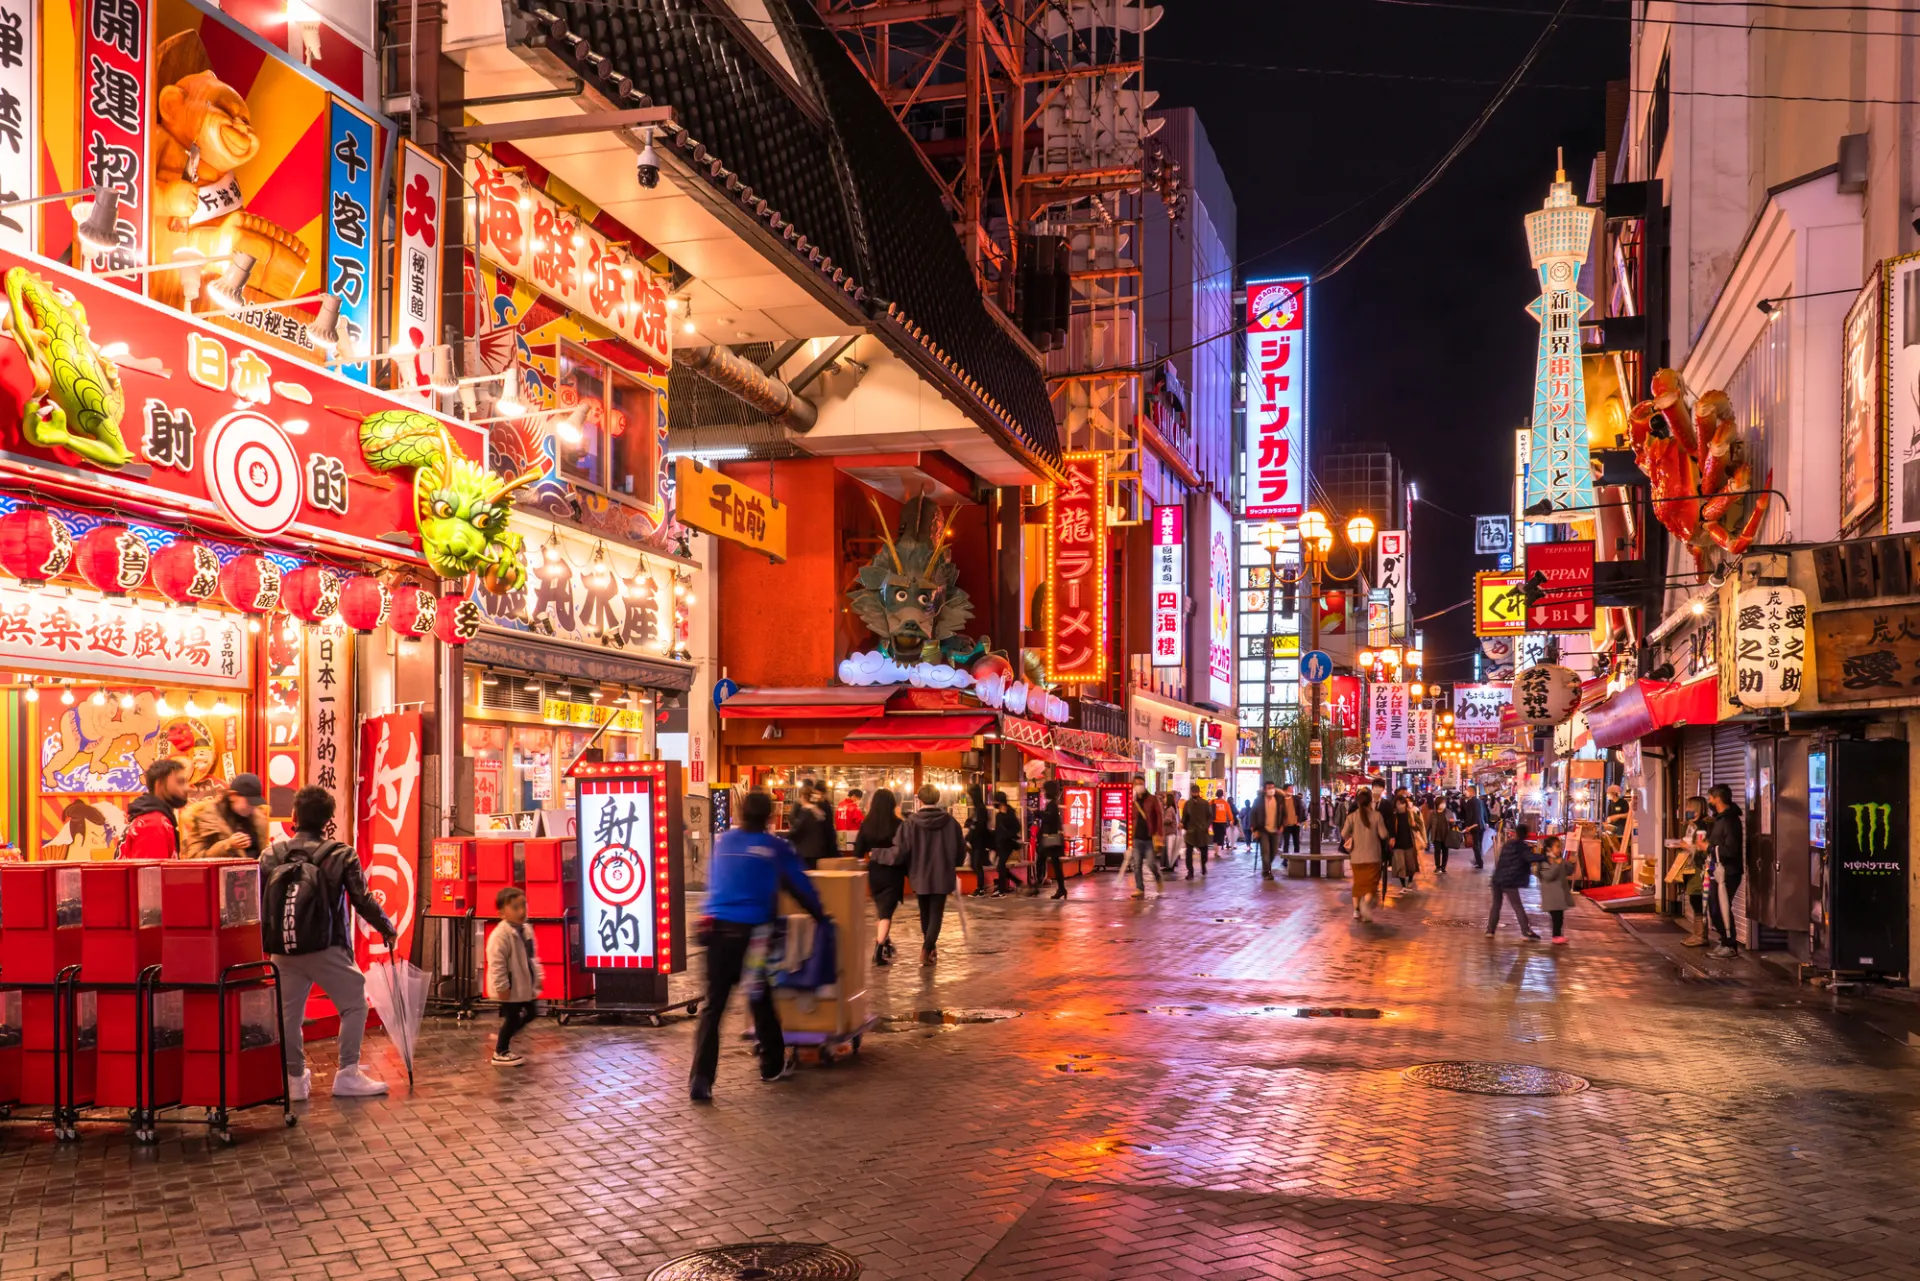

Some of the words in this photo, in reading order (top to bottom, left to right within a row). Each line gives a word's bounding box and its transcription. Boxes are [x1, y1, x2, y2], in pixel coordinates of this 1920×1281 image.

[473, 158, 668, 355] 海鮮浜焼
[410, 252, 427, 319] 秘宝館
[188, 331, 313, 406] 日本一
[1258, 336, 1290, 502] ジャンカラ
[1551, 291, 1570, 511] 新世界串カツいっとく
[709, 484, 766, 542] 千日前
[1481, 523, 1504, 543] 牛角
[118, 532, 149, 588] 大当り
[1055, 465, 1095, 671] 金龍ラーメン
[1545, 546, 1590, 554] TEPPANYAKI
[1157, 592, 1177, 656] 四海樓
[1552, 610, 1568, 622] B1
[1766, 591, 1782, 671] 炭火やきとり
[1738, 604, 1766, 693] 愛之助
[1779, 604, 1806, 692] 愛之助
[1843, 649, 1920, 691] 愛
[1391, 685, 1403, 739] がんばれミナミ
[1522, 669, 1552, 719] 鉄板神社
[317, 639, 337, 841] 日本一射的秘館
[1418, 711, 1427, 753] がんばれミナミ
[1466, 733, 1487, 743] No.1
[594, 796, 639, 851] 射
[593, 848, 639, 870] 大当り
[1844, 861, 1900, 870] MONSTER
[283, 881, 299, 954] DIESEL
[597, 903, 640, 953] 的
